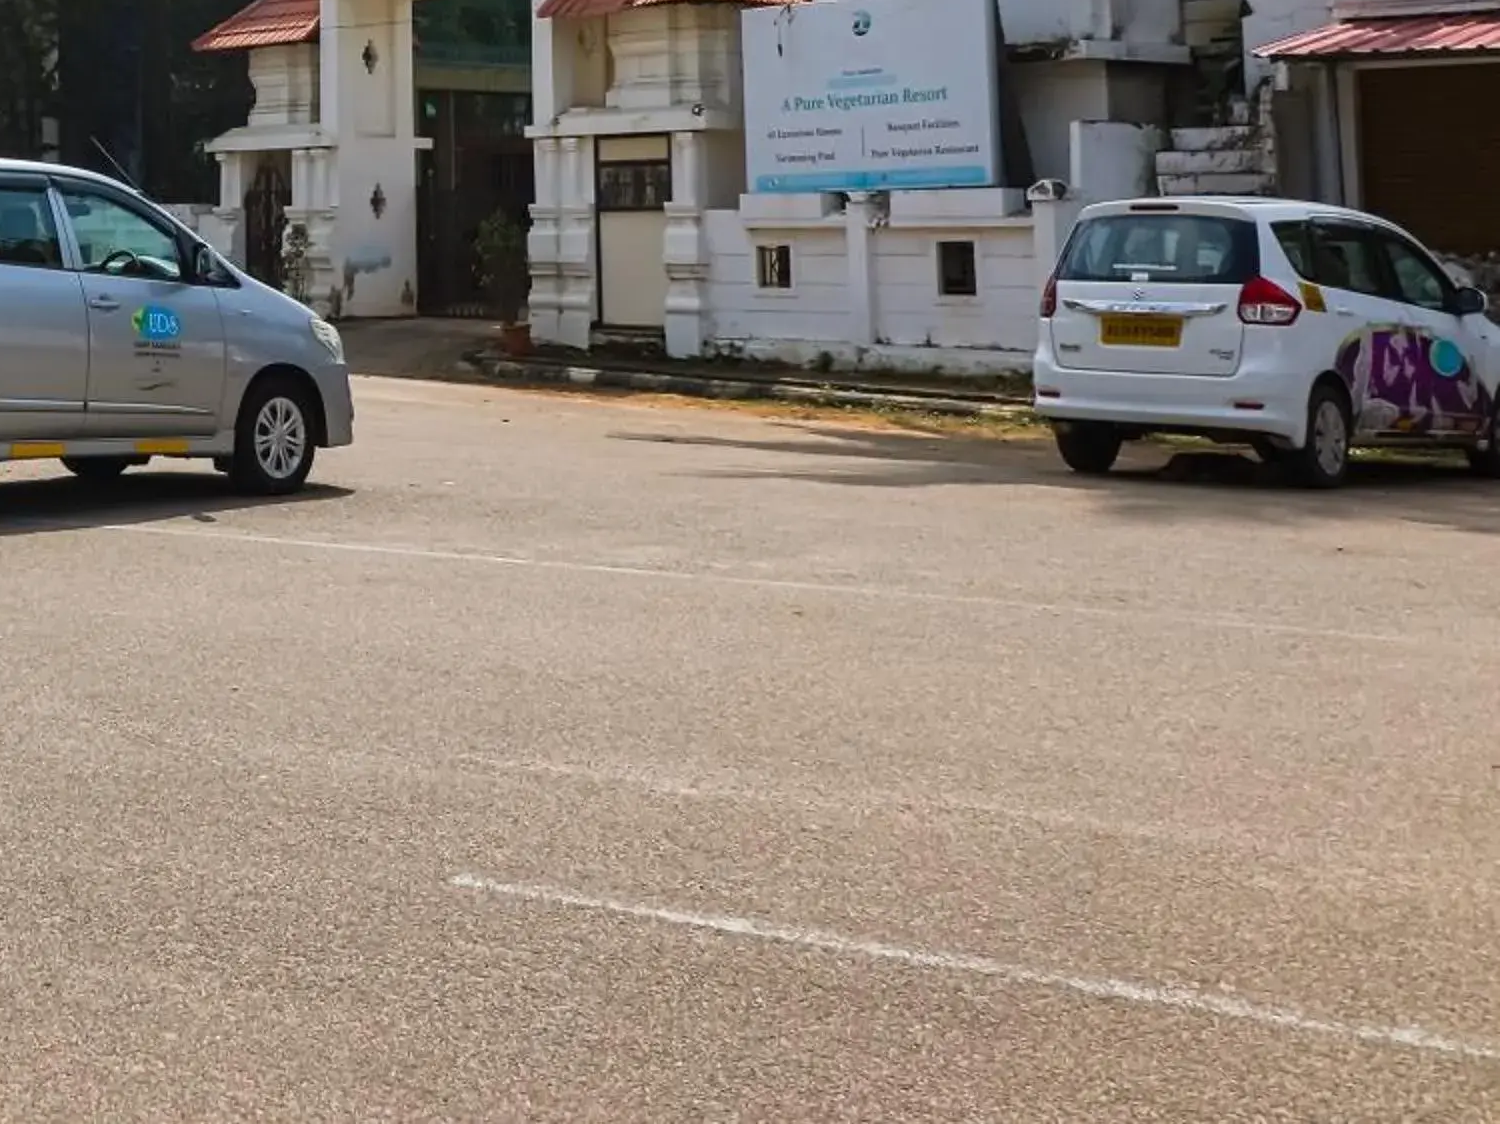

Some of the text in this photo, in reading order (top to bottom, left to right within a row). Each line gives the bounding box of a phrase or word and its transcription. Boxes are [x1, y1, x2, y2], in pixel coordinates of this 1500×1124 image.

[794, 96, 825, 112] Pure
[827, 91, 899, 111] Vegetarian
[902, 85, 948, 103] Resort
